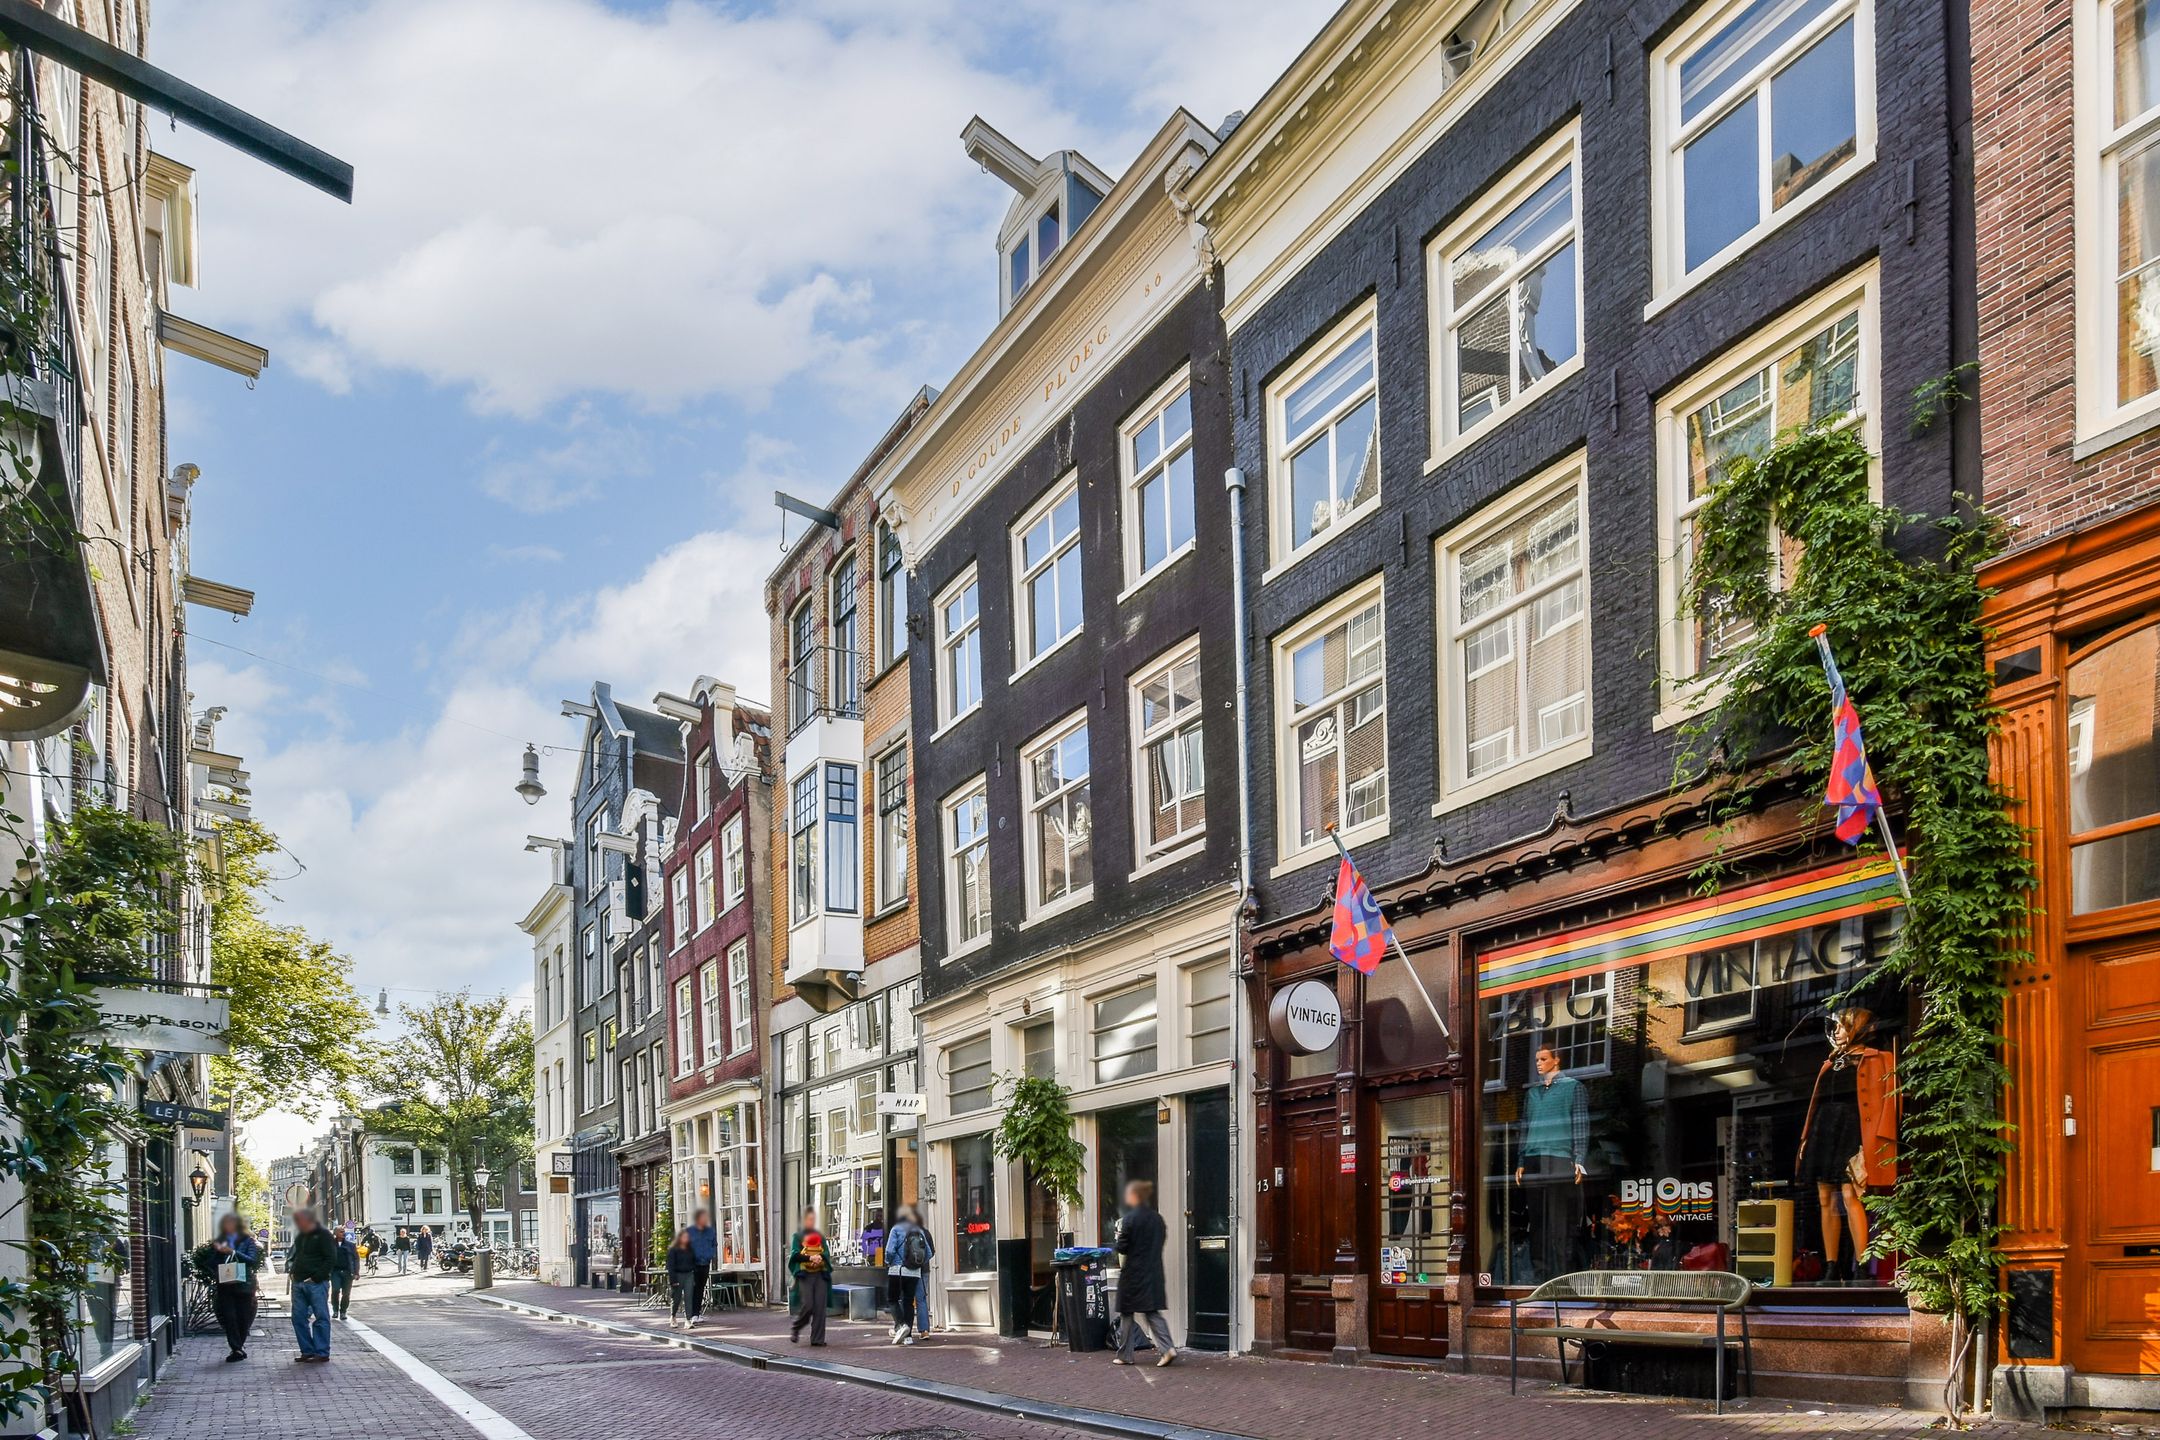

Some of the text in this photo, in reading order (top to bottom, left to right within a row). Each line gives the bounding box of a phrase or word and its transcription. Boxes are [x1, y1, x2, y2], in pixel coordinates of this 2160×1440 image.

[968, 415, 1021, 479] GOUDE
[1685, 920, 1899, 998] VINTAGE
[1290, 1005, 1337, 1027] VINTAGE
[179, 1019, 219, 1031] SON
[895, 1098, 920, 1108] MAAP
[155, 1106, 173, 1118] LE
[1257, 1179, 1269, 1193] 13
[1621, 1177, 1713, 1211] Bij Ons
[1668, 1213, 1713, 1221] VINTAGE
